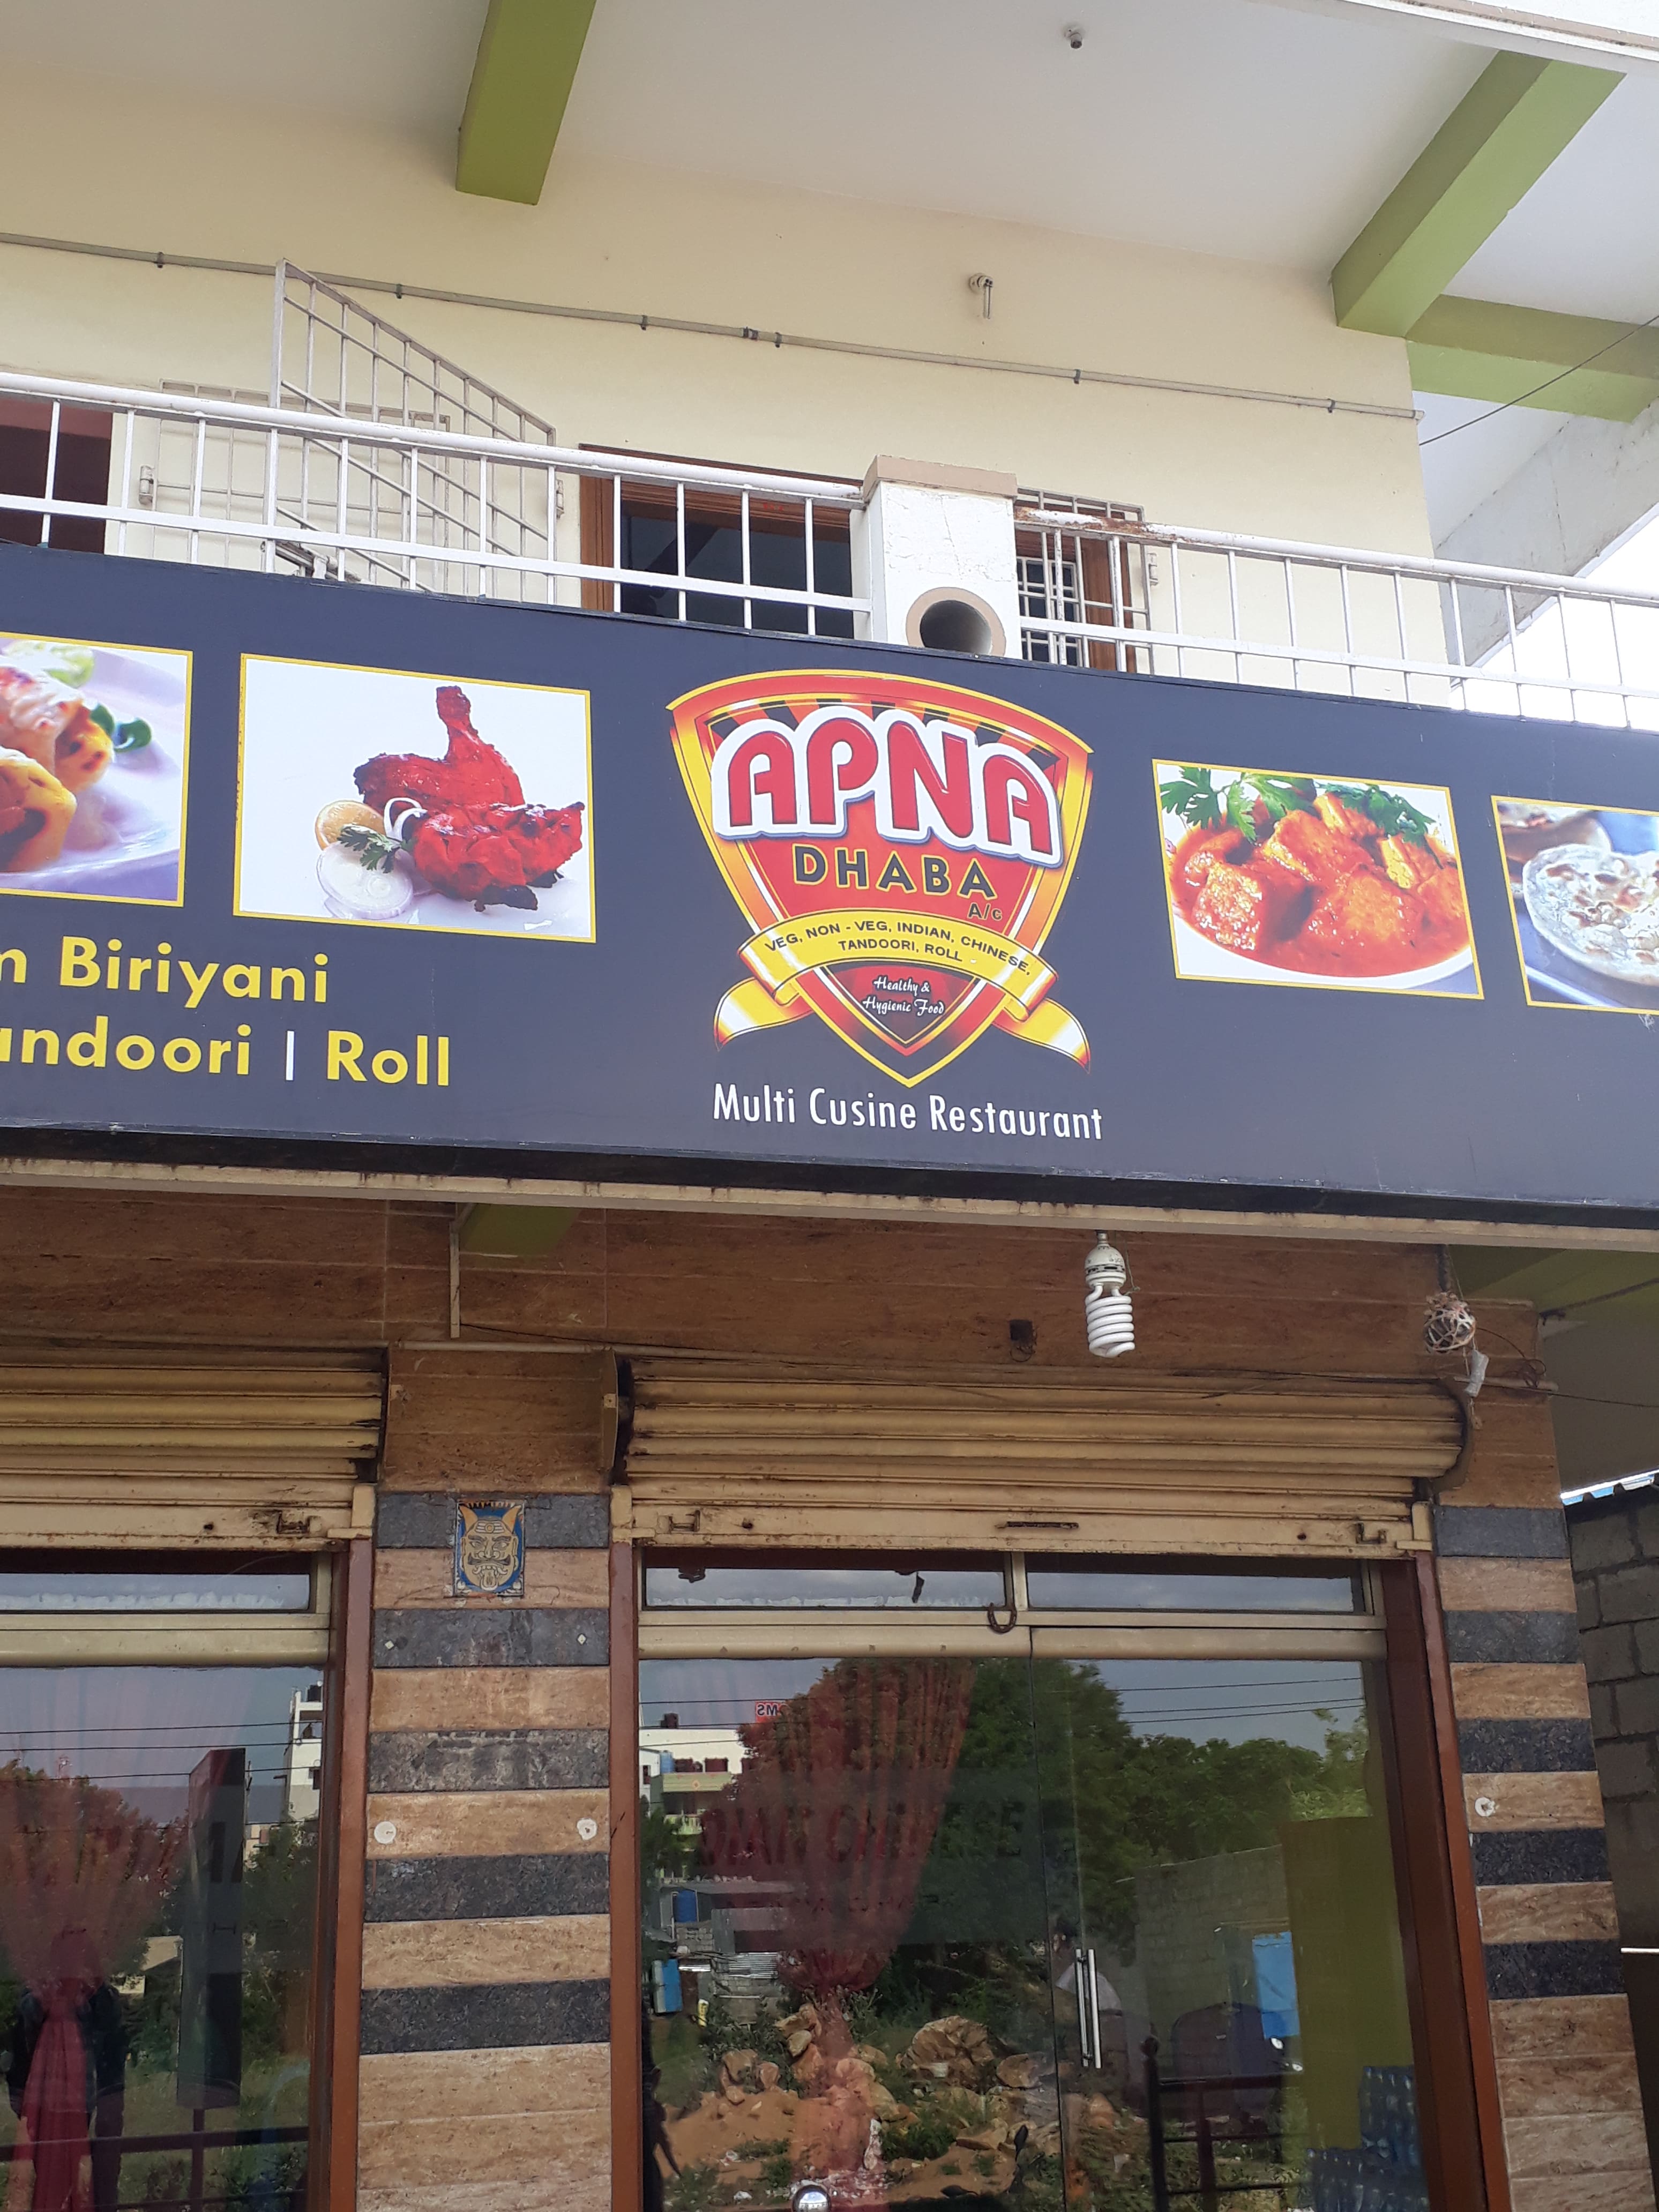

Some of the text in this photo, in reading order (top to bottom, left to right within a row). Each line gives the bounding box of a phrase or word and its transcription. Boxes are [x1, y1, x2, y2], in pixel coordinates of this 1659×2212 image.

[715, 708, 1061, 865] APNA
[793, 845, 998, 900] DHABA
[60, 935, 328, 1008] Biriyani
[764, 932, 803, 952] VEG,
[806, 922, 840, 939] NON
[854, 920, 892, 933] VEG,
[897, 922, 955, 944] INDIAN,
[960, 936, 1032, 976] CHINESE,
[838, 939, 963, 962] TANDOORI, ROLL
[862, 995, 945, 1016] Hygienic Food
[873, 975, 931, 993] Healthy &
[326, 1030, 450, 1086] Roll
[713, 1083, 1103, 1140] Multi Cusine Restaurant
